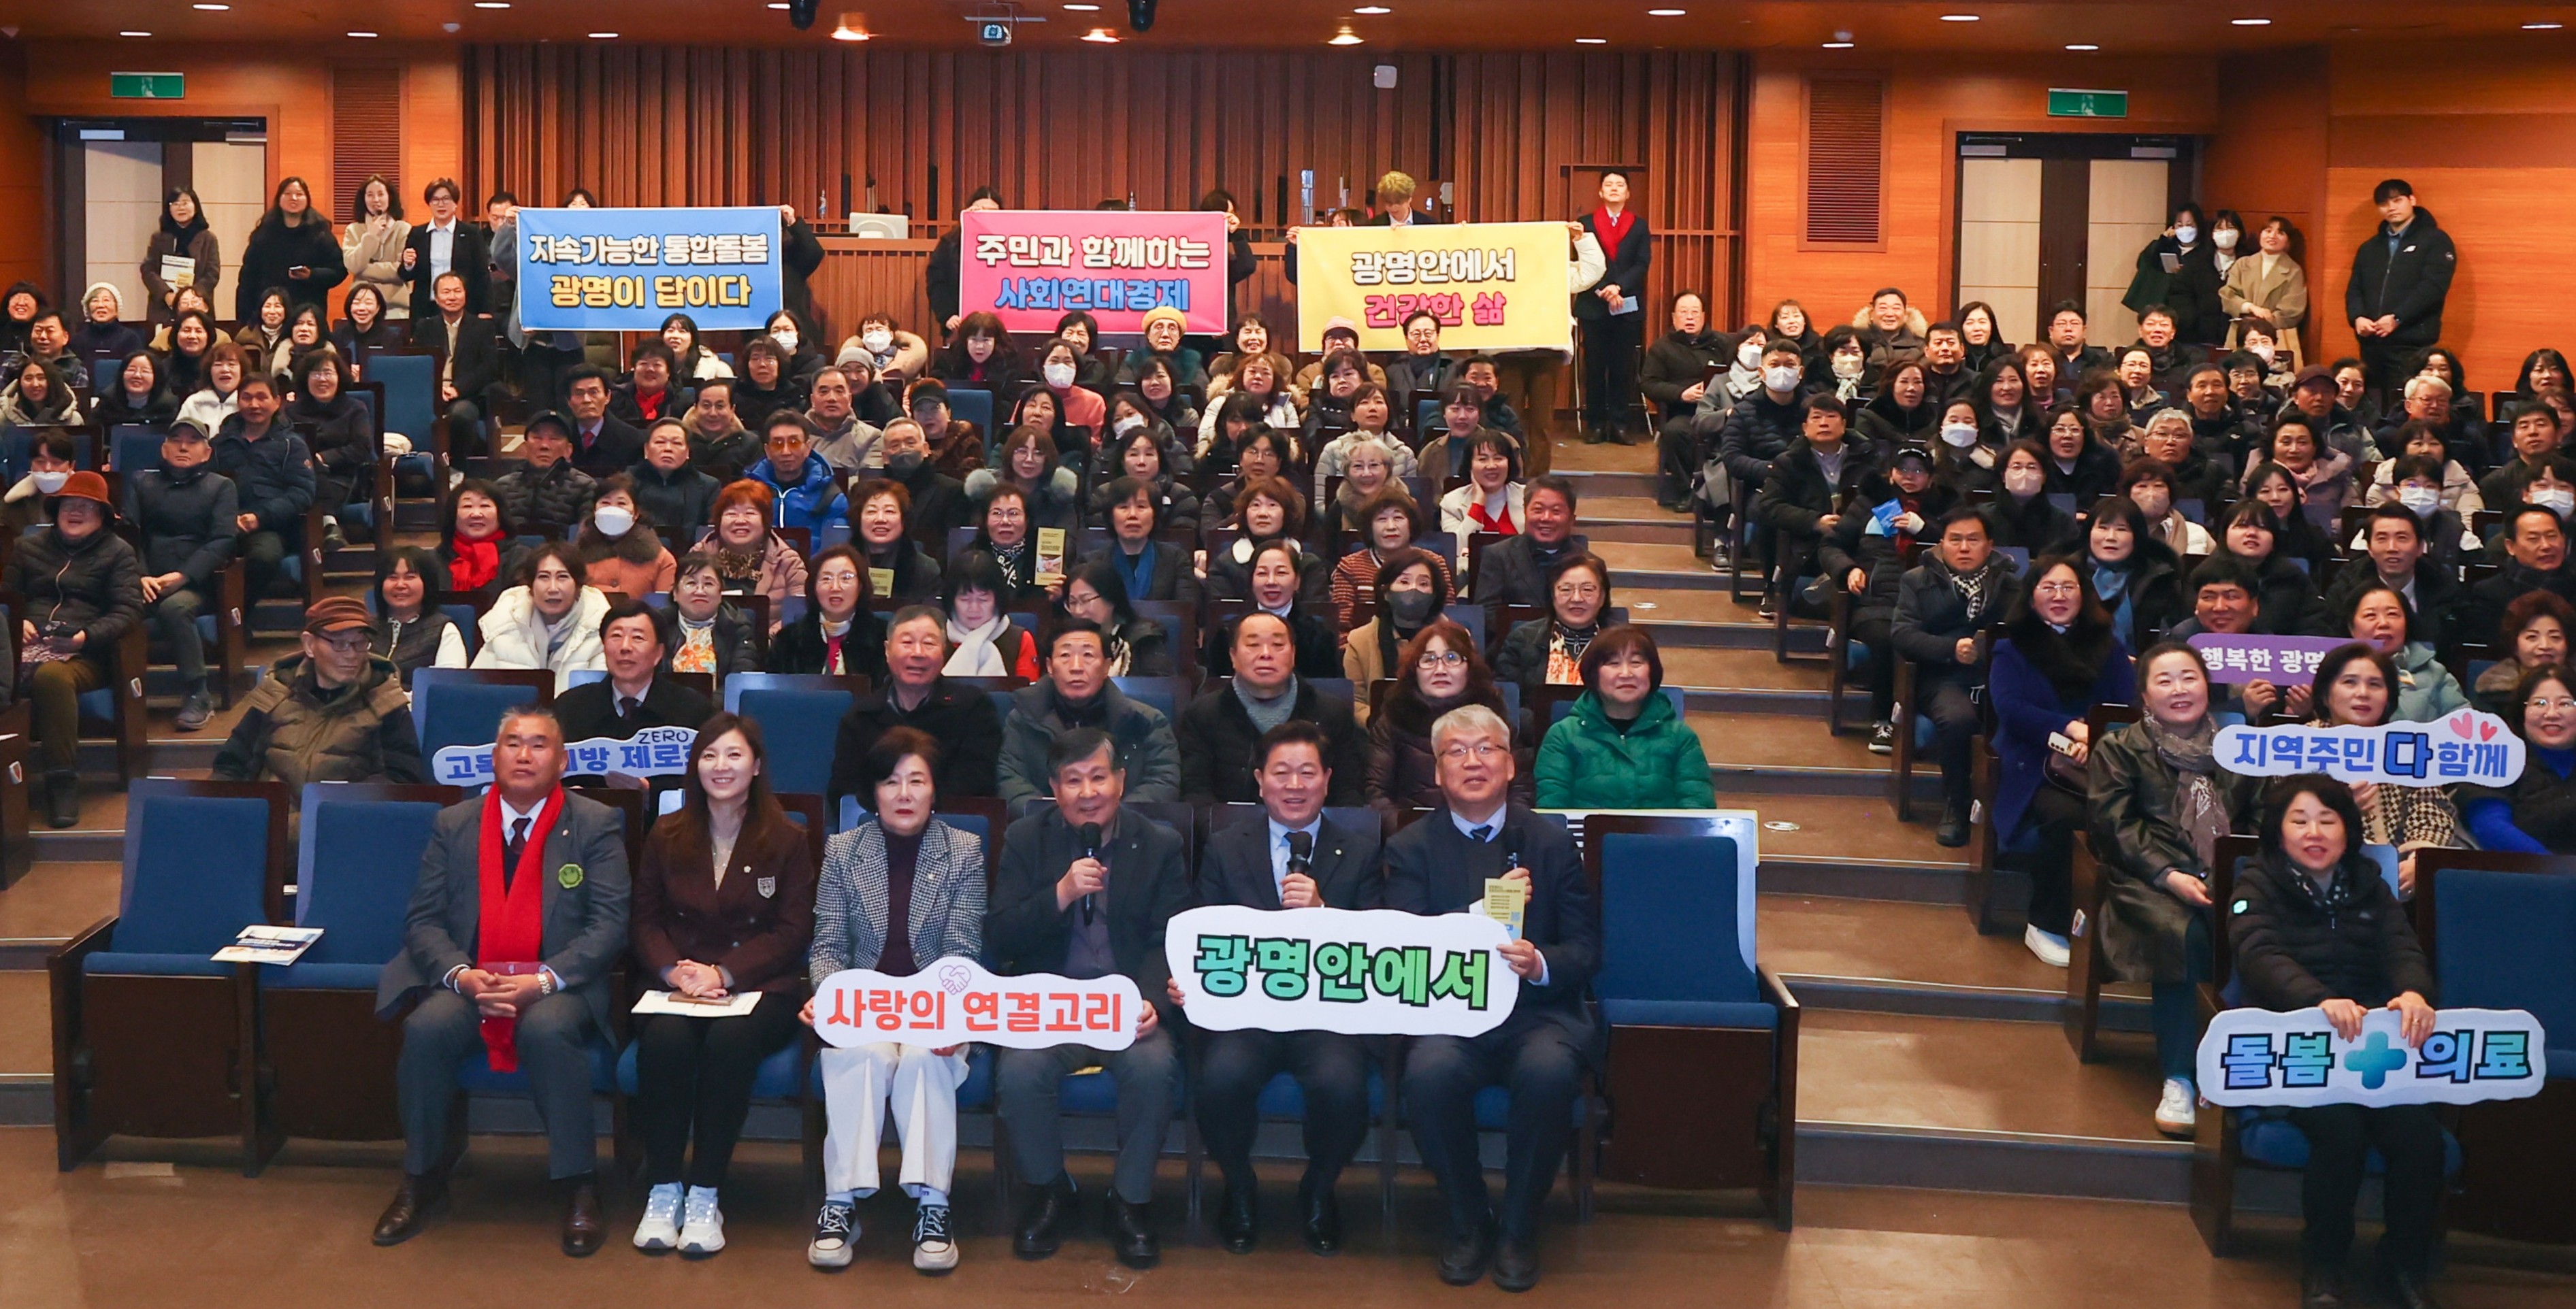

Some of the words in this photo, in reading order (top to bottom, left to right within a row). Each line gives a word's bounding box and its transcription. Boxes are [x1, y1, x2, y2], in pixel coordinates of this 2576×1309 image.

[529, 234, 659, 265] 지속가능한
[663, 233, 768, 265] 통합돌봄
[975, 234, 1074, 267] 주민과
[1080, 234, 1211, 269] 함께하는
[1350, 248, 1516, 285] 광명안에서
[550, 275, 645, 308] 광명이
[653, 274, 752, 308] 답이다
[994, 277, 1191, 312] 사회연대경제
[1364, 292, 1465, 329] 건강한
[1471, 291, 1507, 326] 삶
[2200, 647, 2272, 672] 행복한
[638, 730, 689, 744] ZERO
[2234, 733, 2375, 772] 지역주민
[1194, 934, 1490, 1011] 광명안에서
[827, 989, 945, 1031] 사랑의
[962, 991, 1121, 1033] 연결고리
[2221, 1032, 2336, 1089] 돌봄
[2415, 1029, 2532, 1084] 의료
